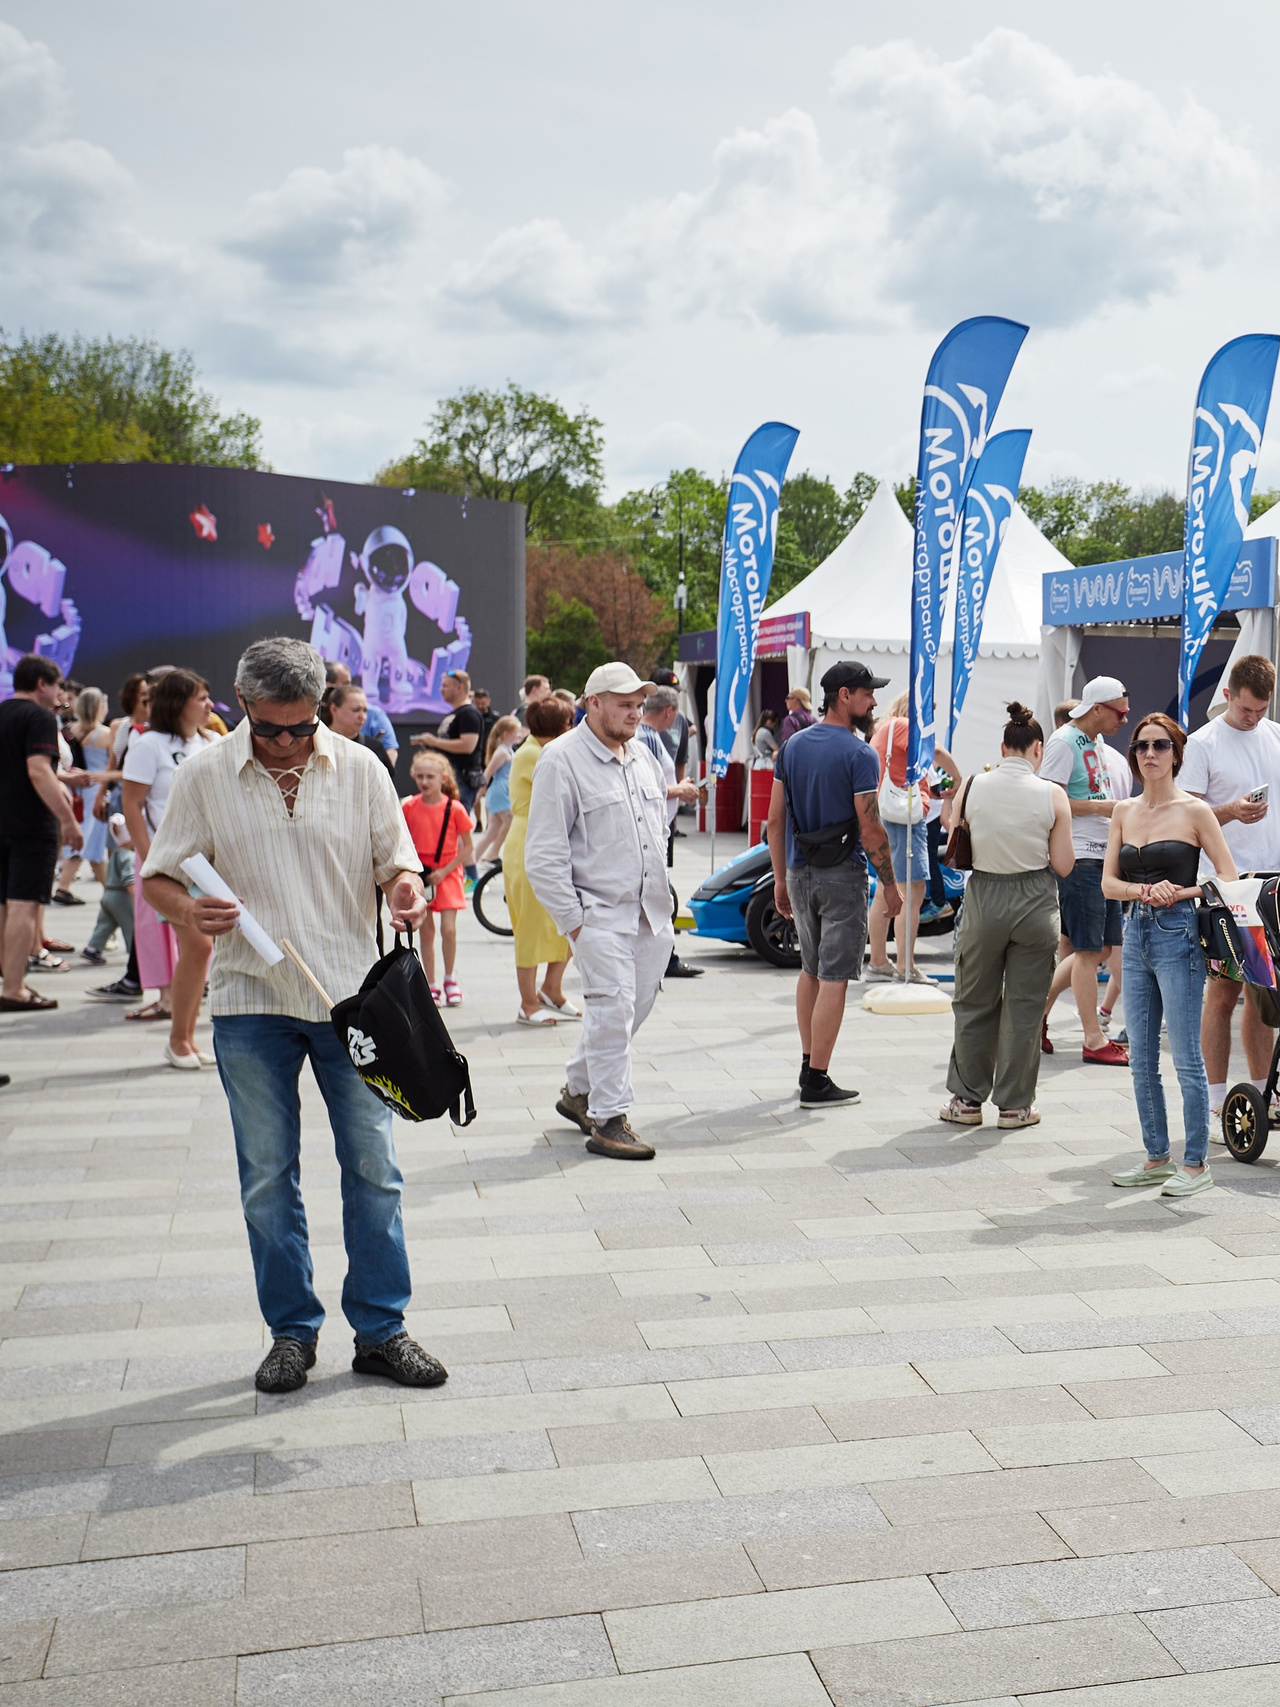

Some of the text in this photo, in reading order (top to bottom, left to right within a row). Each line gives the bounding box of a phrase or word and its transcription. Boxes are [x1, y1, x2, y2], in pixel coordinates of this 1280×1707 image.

[732, 502, 763, 678] Мотошк
[924, 427, 957, 619] Мотошк
[964, 516, 984, 643] Мотош
[1192, 445, 1218, 632] Мотошк
